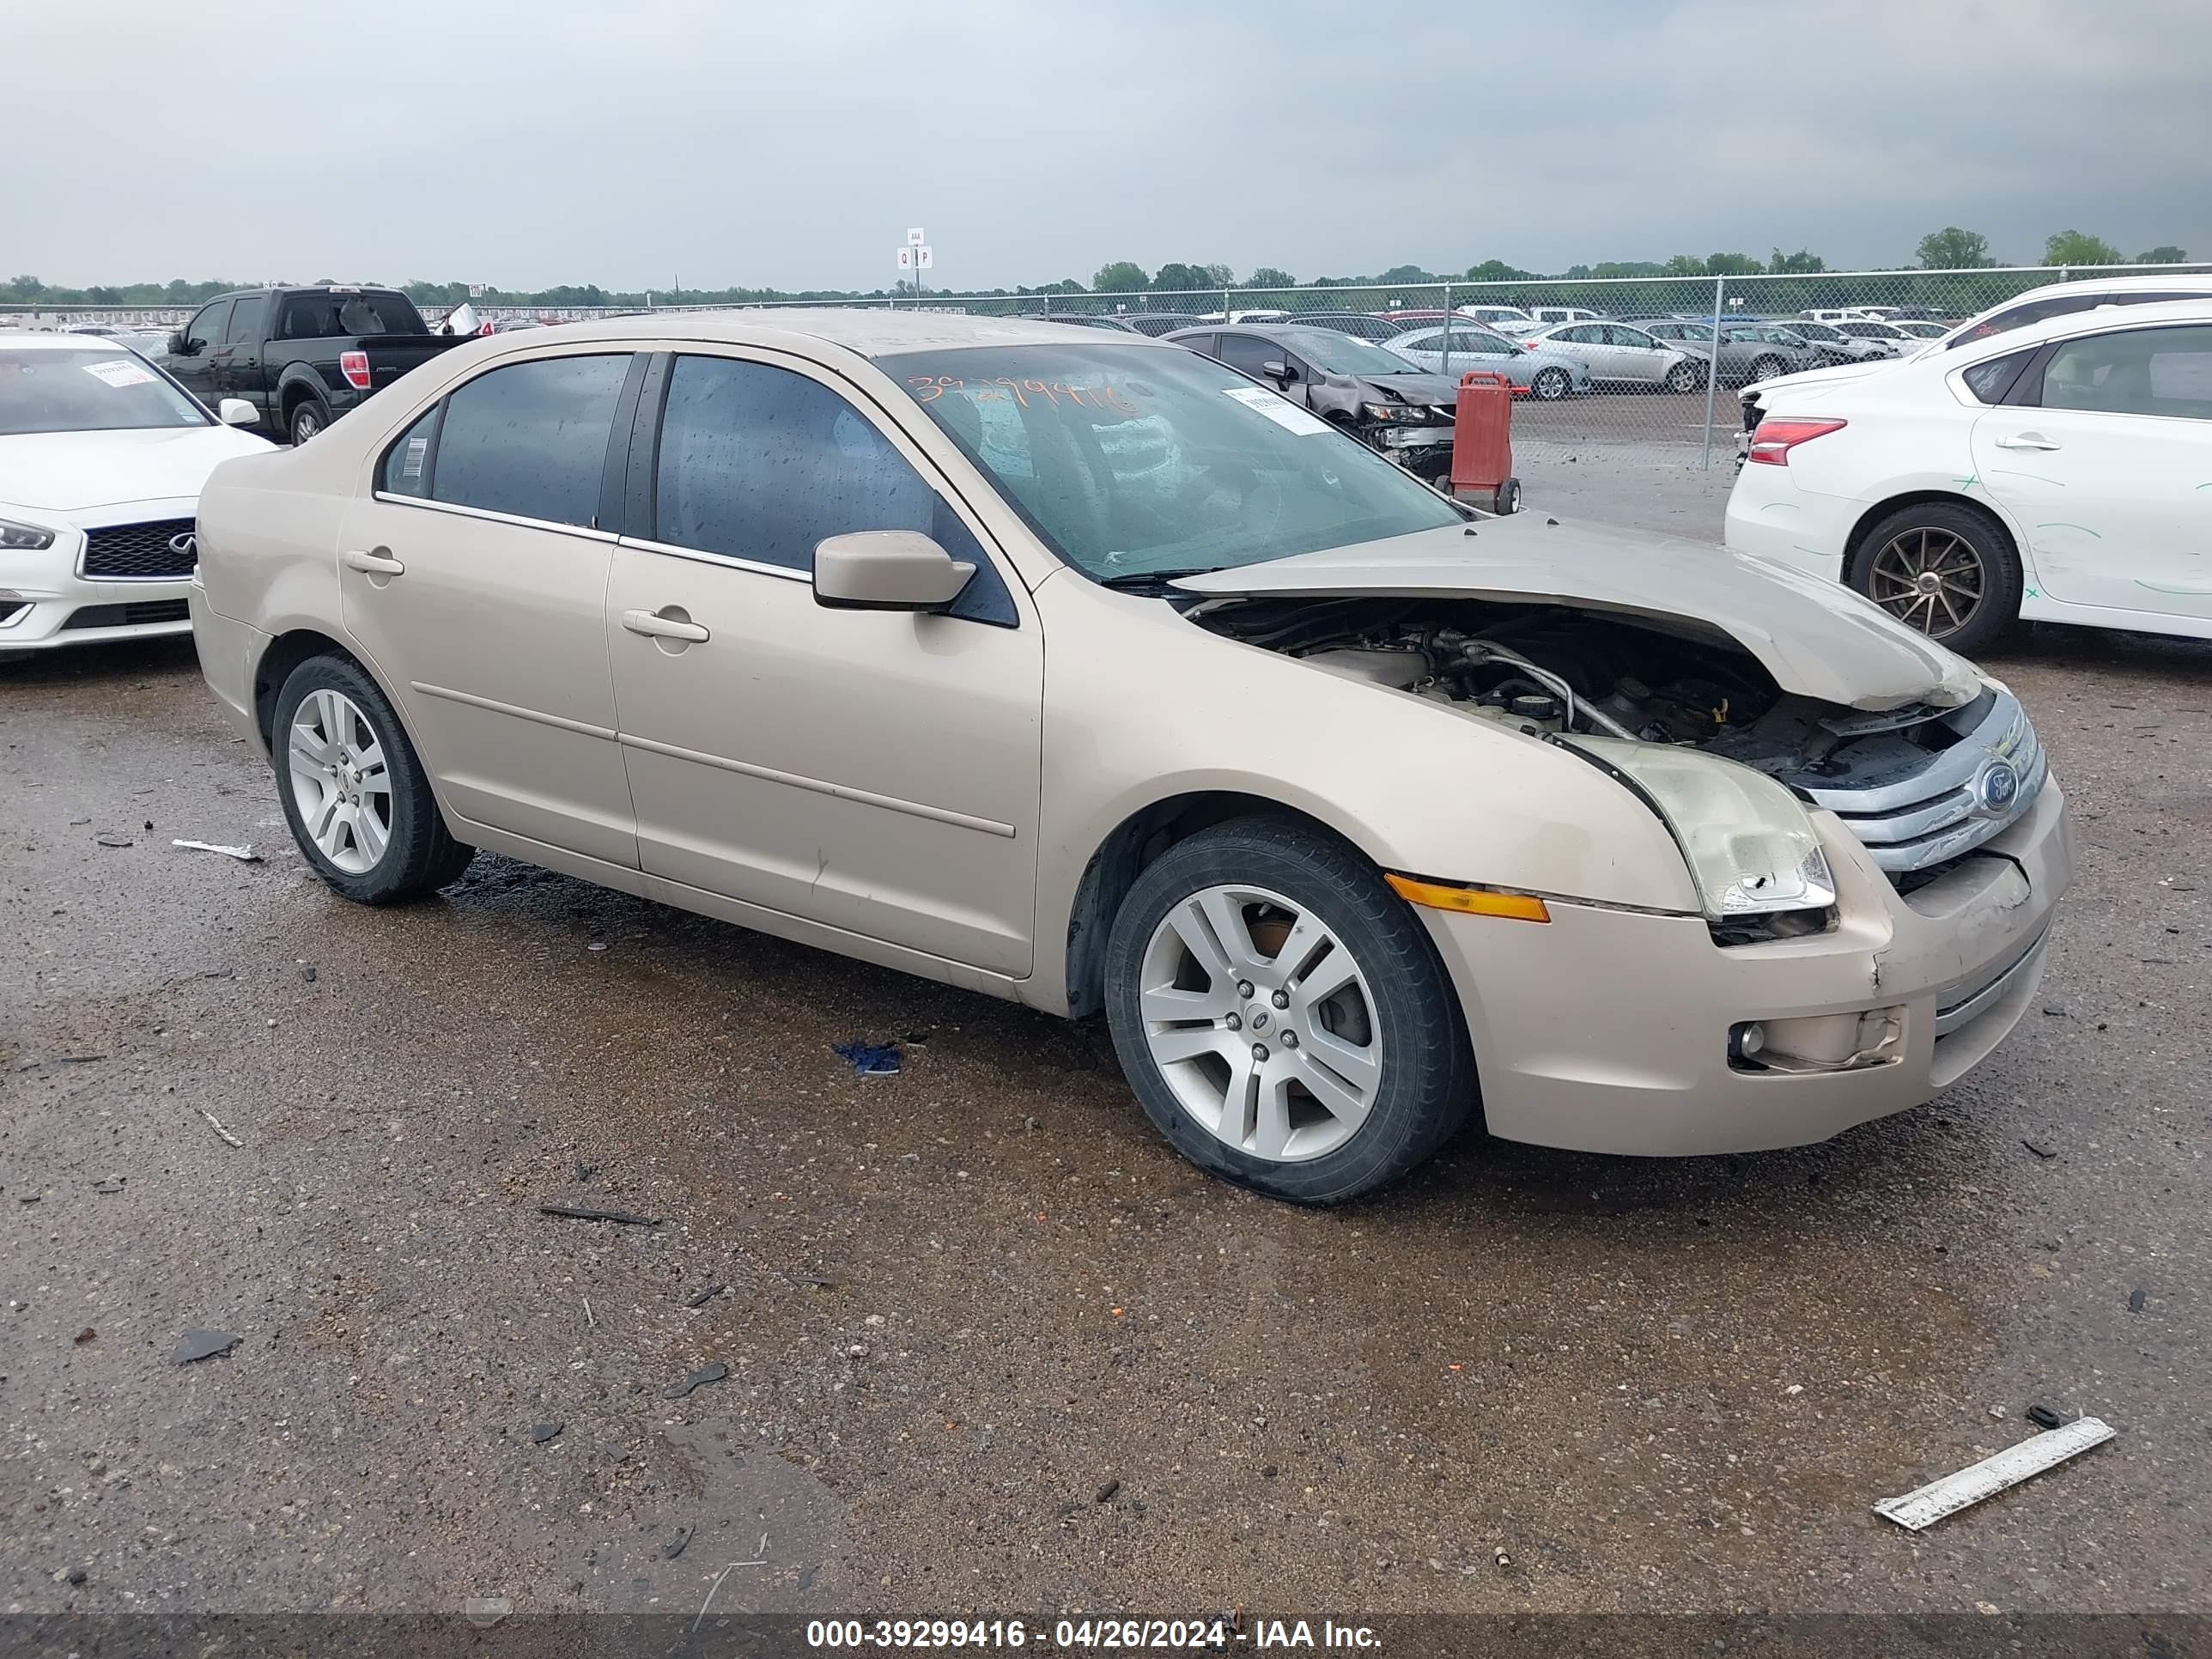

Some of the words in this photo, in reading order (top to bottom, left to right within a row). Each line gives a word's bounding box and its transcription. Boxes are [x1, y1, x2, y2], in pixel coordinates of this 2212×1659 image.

[902, 253, 908, 264] Q
[922, 252, 928, 263] P
[470, 286, 481, 296] 170
[1992, 771, 2014, 800] Ford
